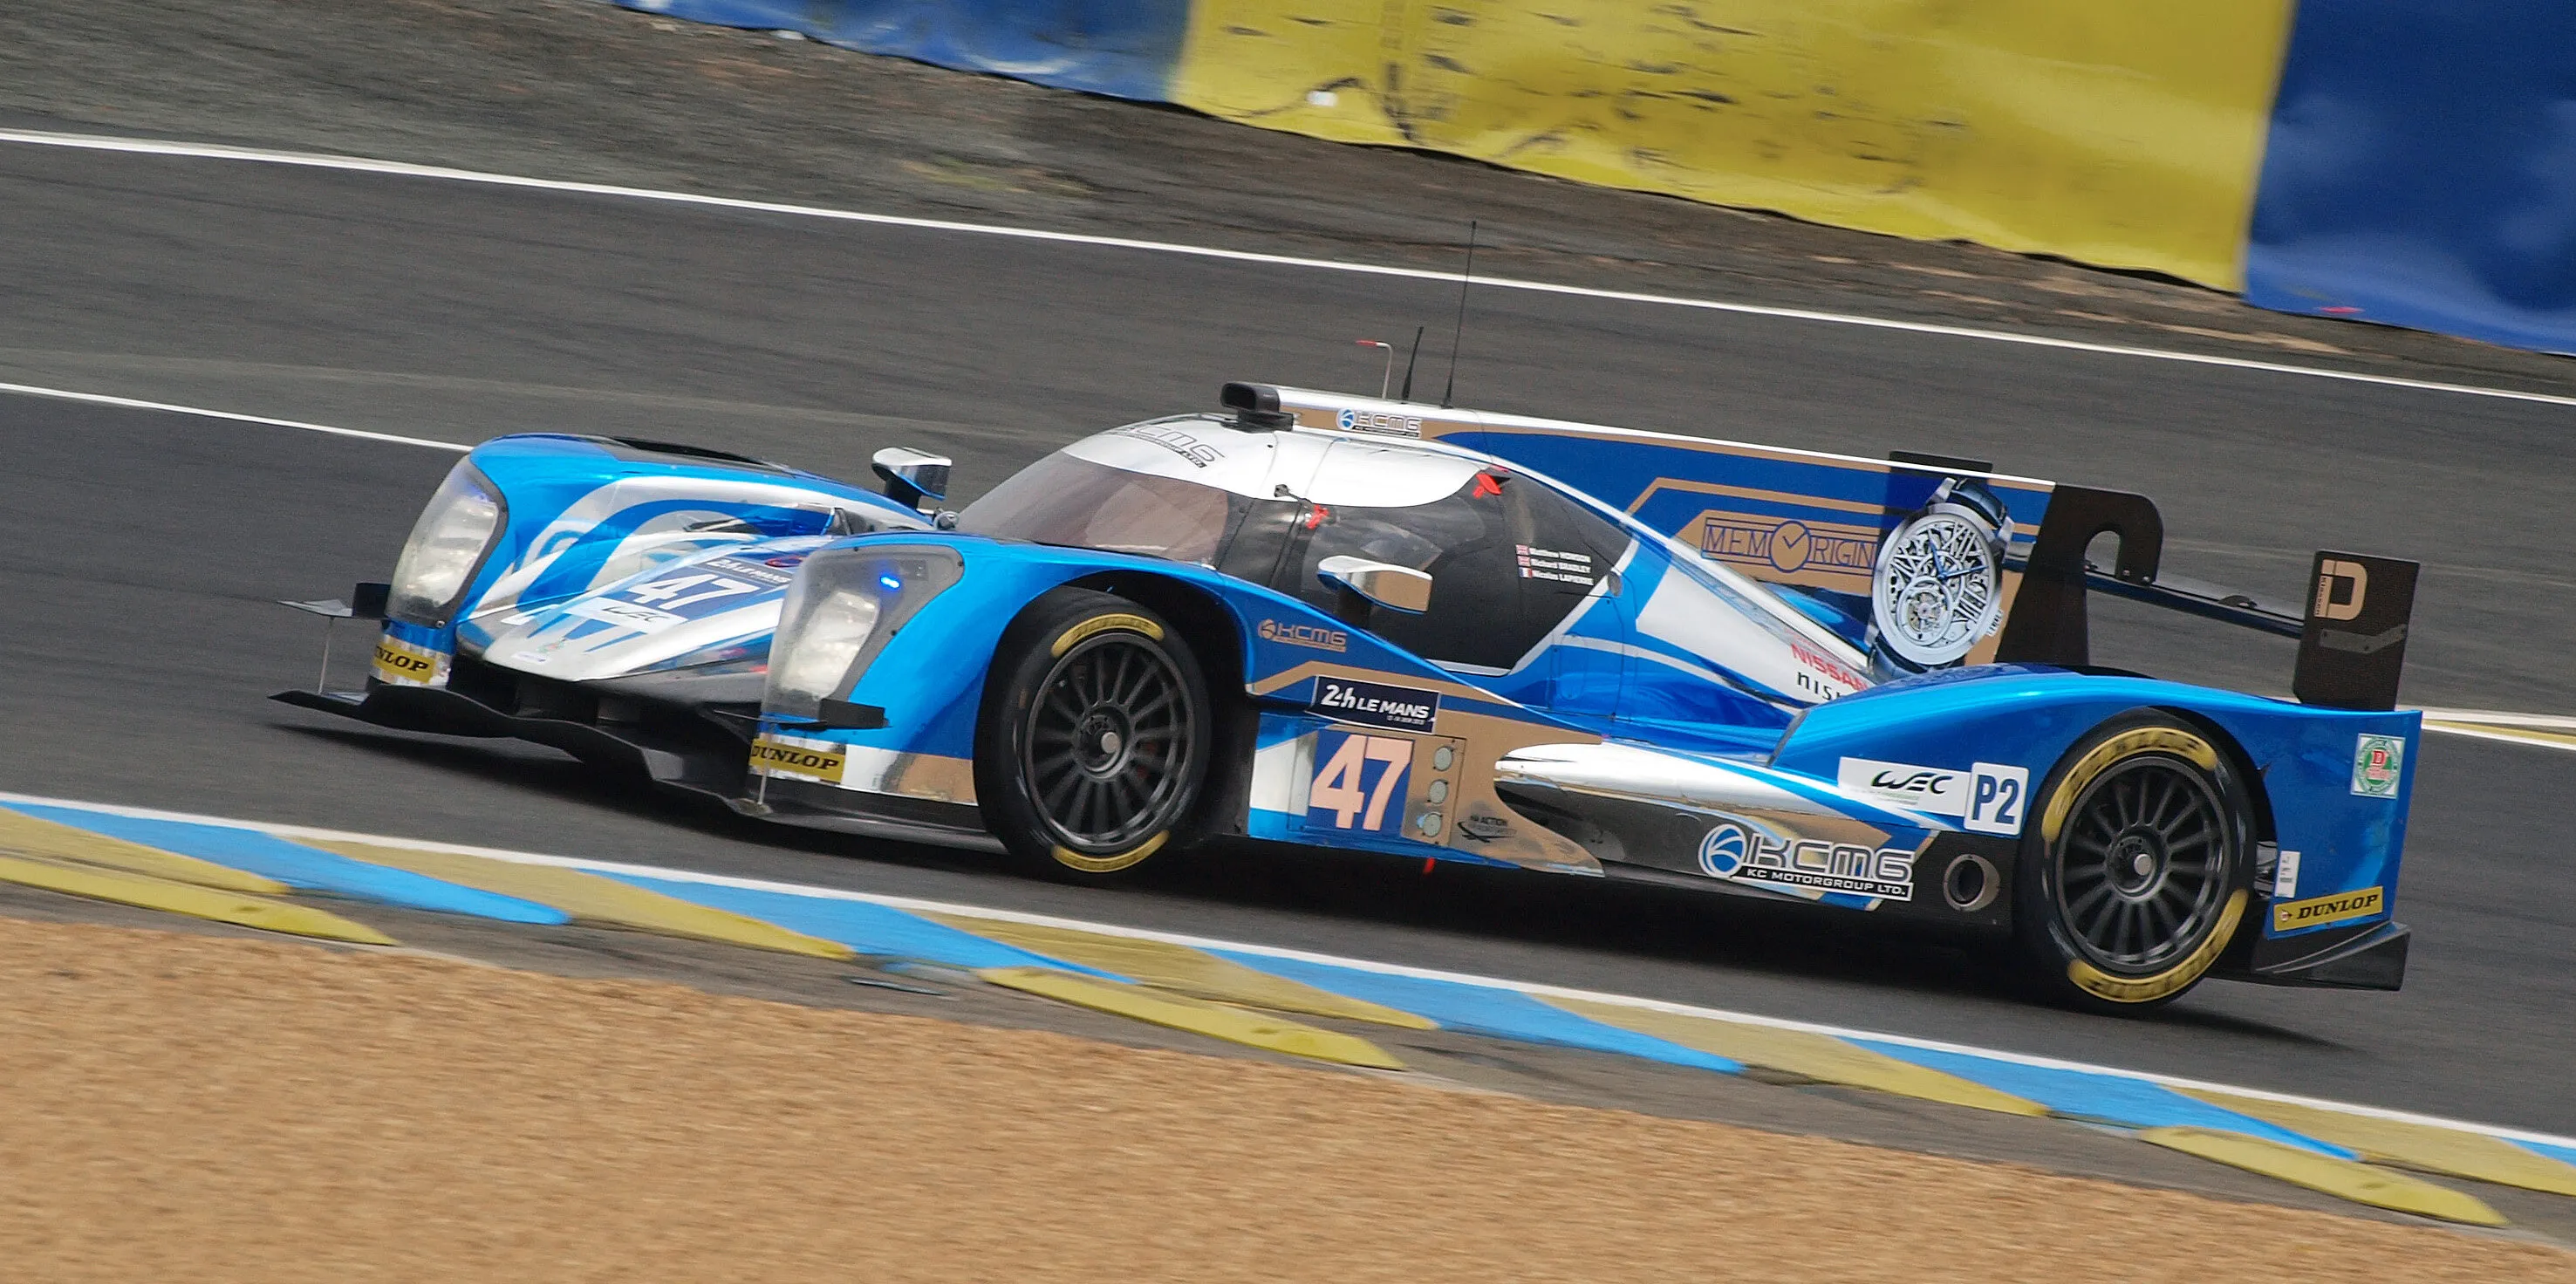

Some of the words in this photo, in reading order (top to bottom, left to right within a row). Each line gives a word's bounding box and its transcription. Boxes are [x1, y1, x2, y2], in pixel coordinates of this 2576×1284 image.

[625, 573, 761, 611] 47
[1277, 622, 1348, 646] KCMG
[375, 645, 429, 672] NLOP
[1791, 641, 1869, 692] NISSAN
[1356, 697, 1377, 713] LE
[1378, 700, 1431, 719] MANS
[1308, 734, 1414, 831] 47
[1870, 770, 1954, 795] WEC
[1971, 774, 2020, 825] P2
[1746, 832, 1917, 884] KCMG
[1746, 868, 1767, 878] KC
[1771, 871, 1875, 891] MOTORGROUP
[1876, 884, 1907, 896] LTD.
[2297, 894, 2379, 919] DUNLOP
